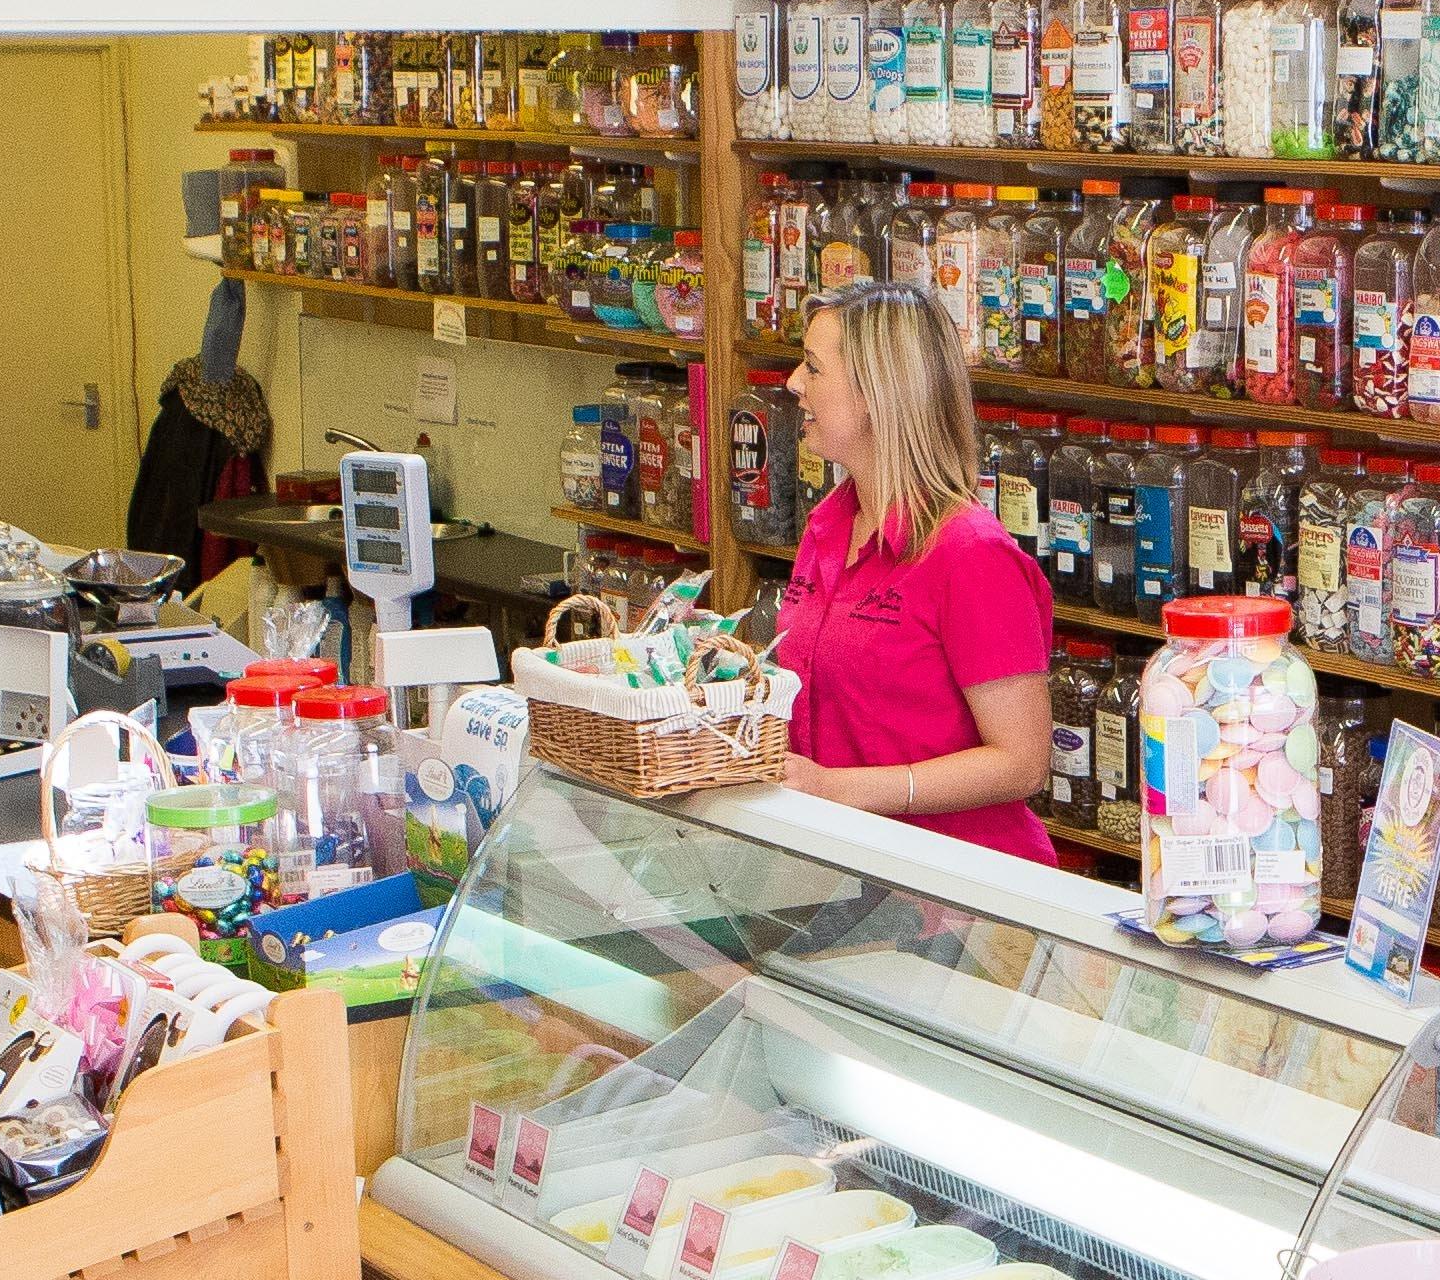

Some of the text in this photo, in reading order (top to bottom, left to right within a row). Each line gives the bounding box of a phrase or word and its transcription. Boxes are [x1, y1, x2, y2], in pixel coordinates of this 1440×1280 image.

[733, 423, 758, 444] ARMY
[735, 450, 758, 469] NAVY
[466, 720, 492, 741] save
